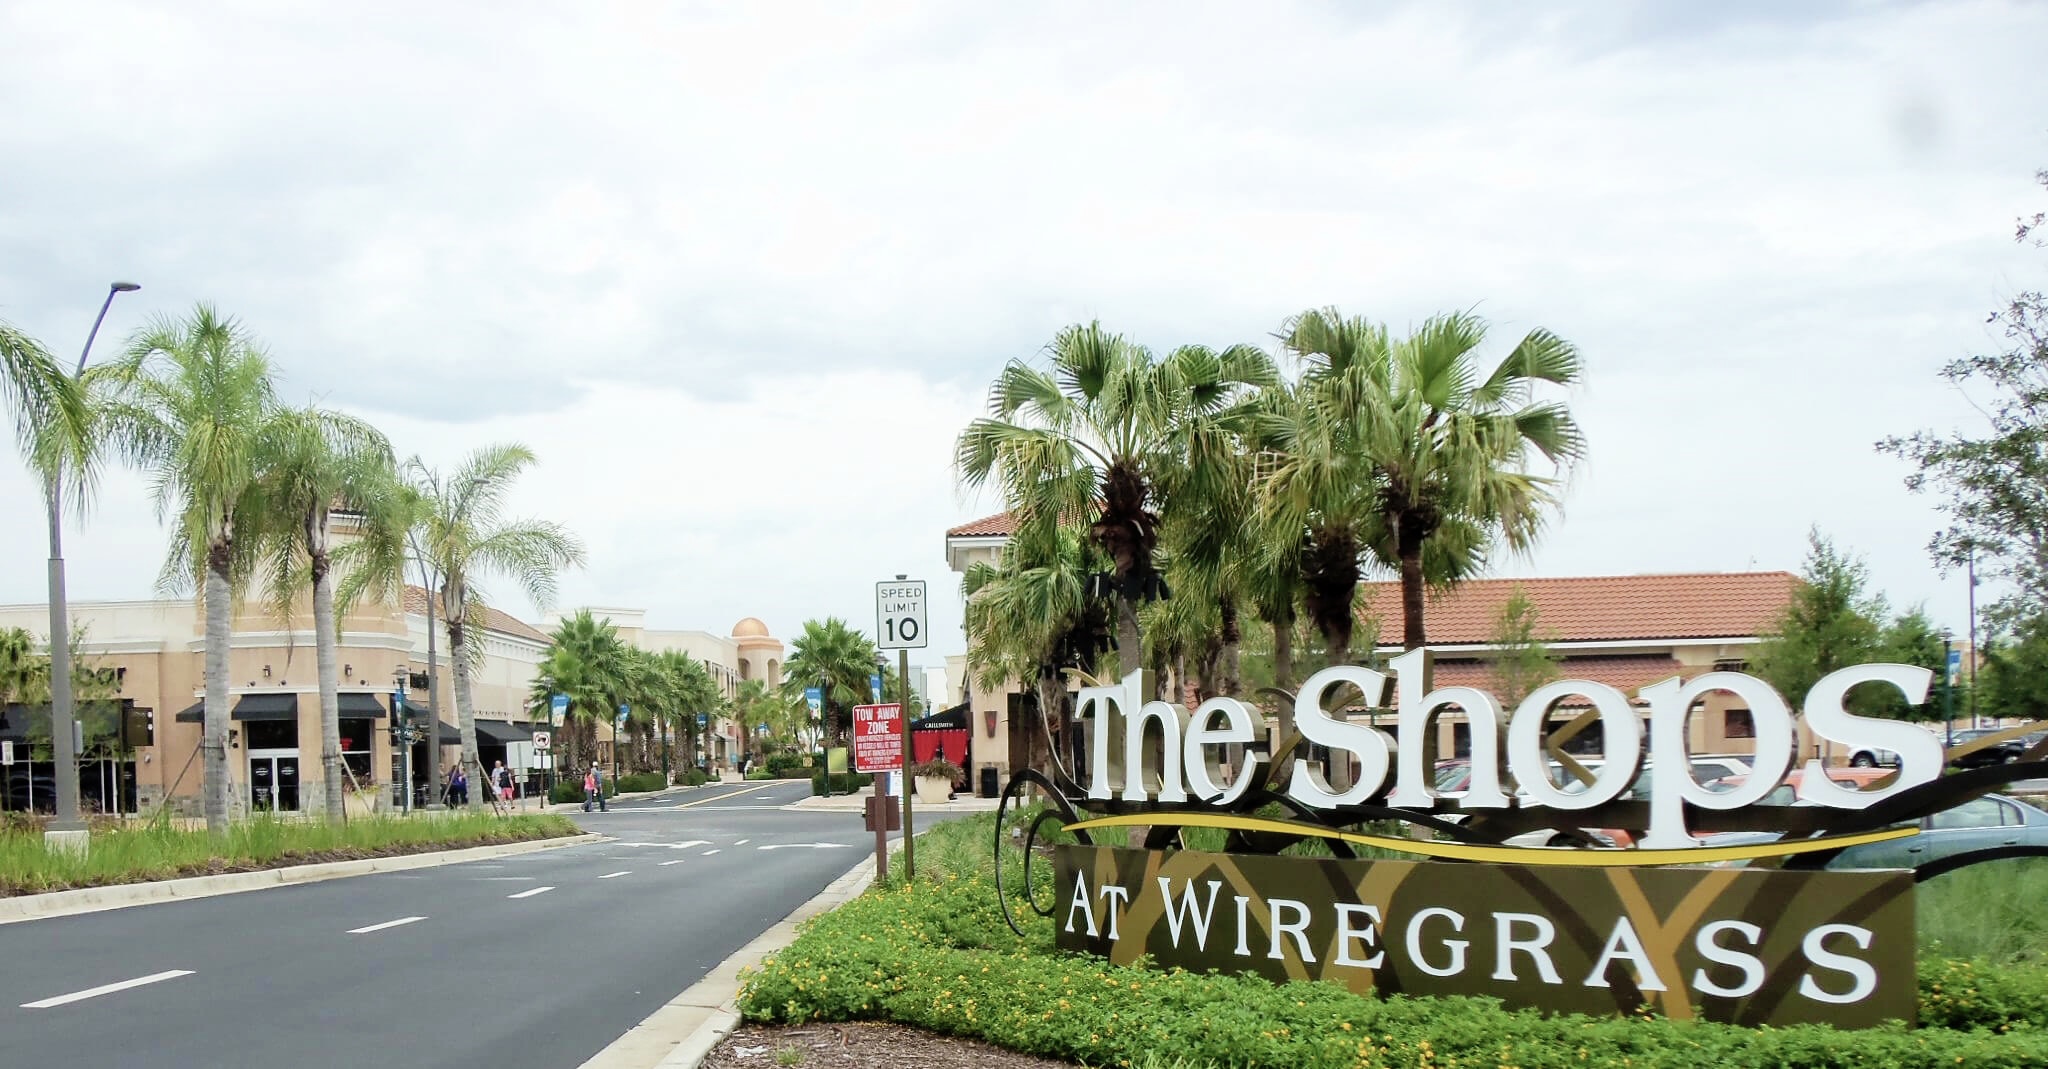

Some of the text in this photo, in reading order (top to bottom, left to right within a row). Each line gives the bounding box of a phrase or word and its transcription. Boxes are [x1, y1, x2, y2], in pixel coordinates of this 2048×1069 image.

[881, 588, 922, 598] SPEED
[885, 602, 918, 613] LIMIT
[885, 617, 919, 641] 10
[855, 706, 901, 721] TOW AWAY
[867, 720, 890, 735] ZONE
[1075, 647, 1945, 850] The Shops
[1064, 868, 1878, 1004] AT WIREGRASS
